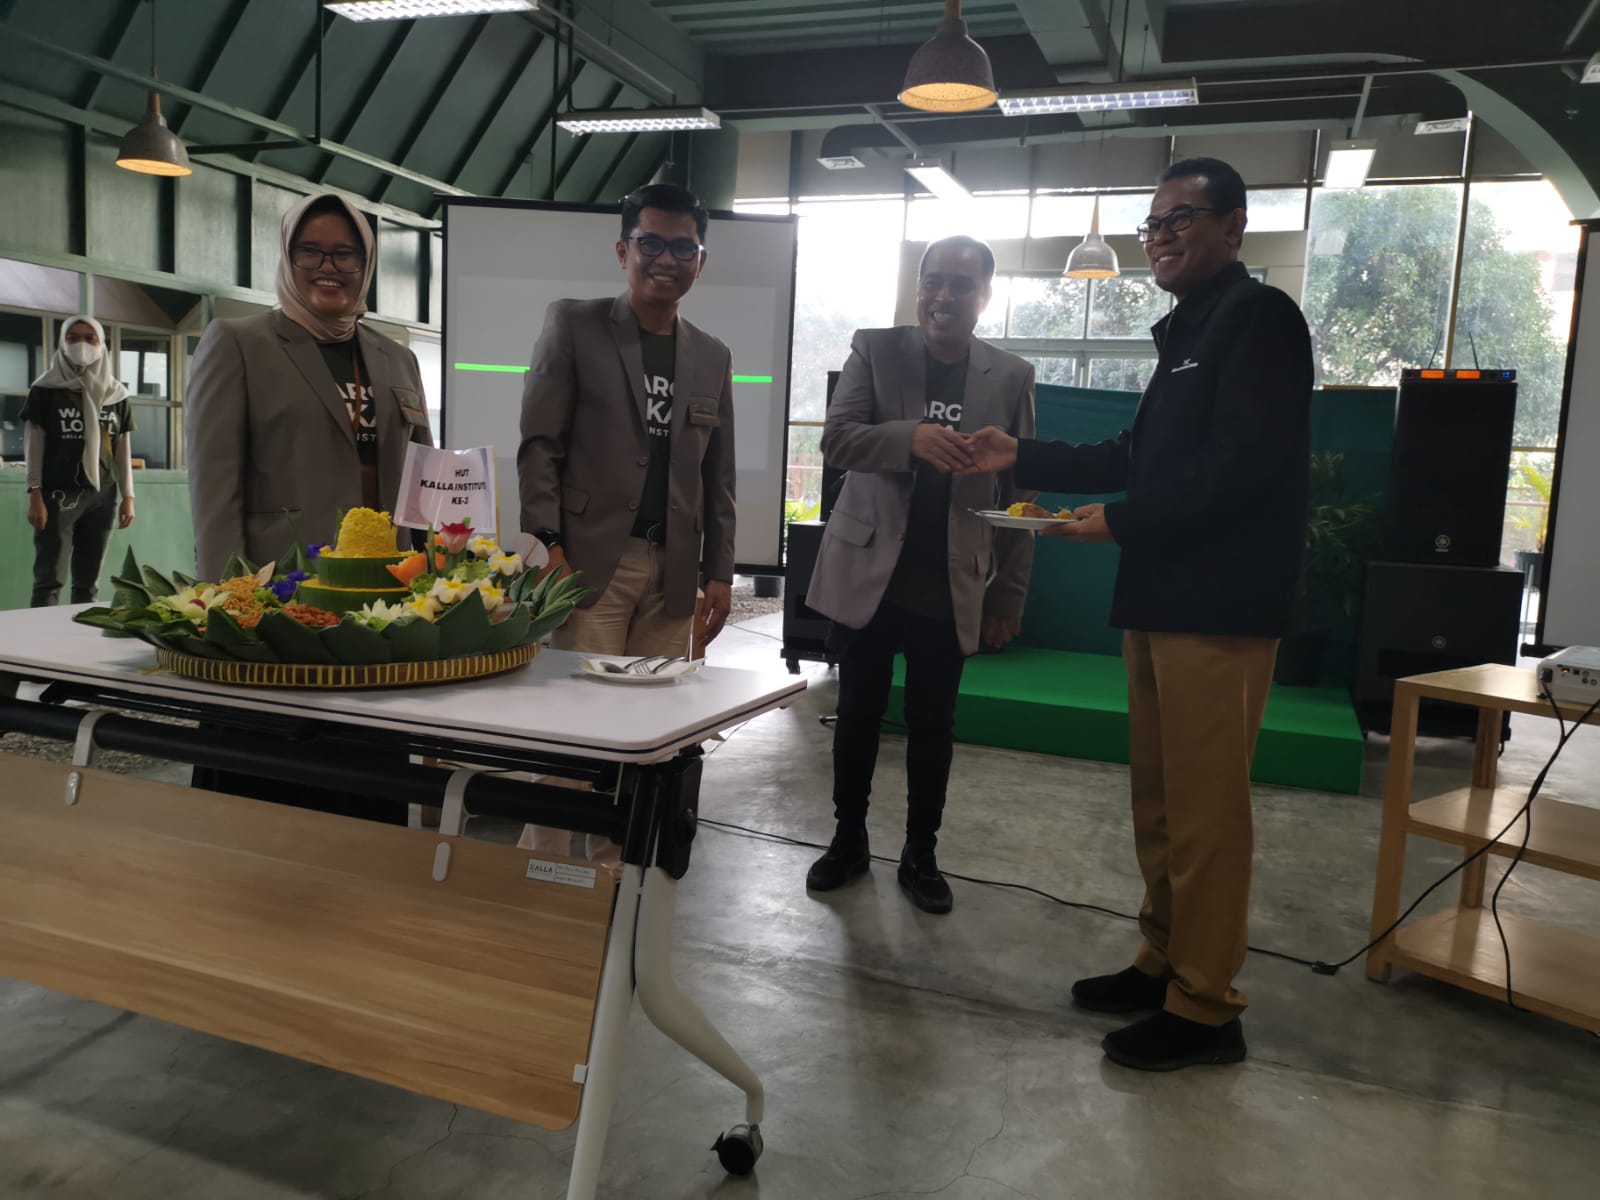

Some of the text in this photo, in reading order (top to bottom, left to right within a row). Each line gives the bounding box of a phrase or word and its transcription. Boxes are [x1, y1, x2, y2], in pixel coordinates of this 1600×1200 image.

[924, 400, 962, 422] RG
[455, 468, 470, 479] HUT
[420, 480, 454, 492] KALLA
